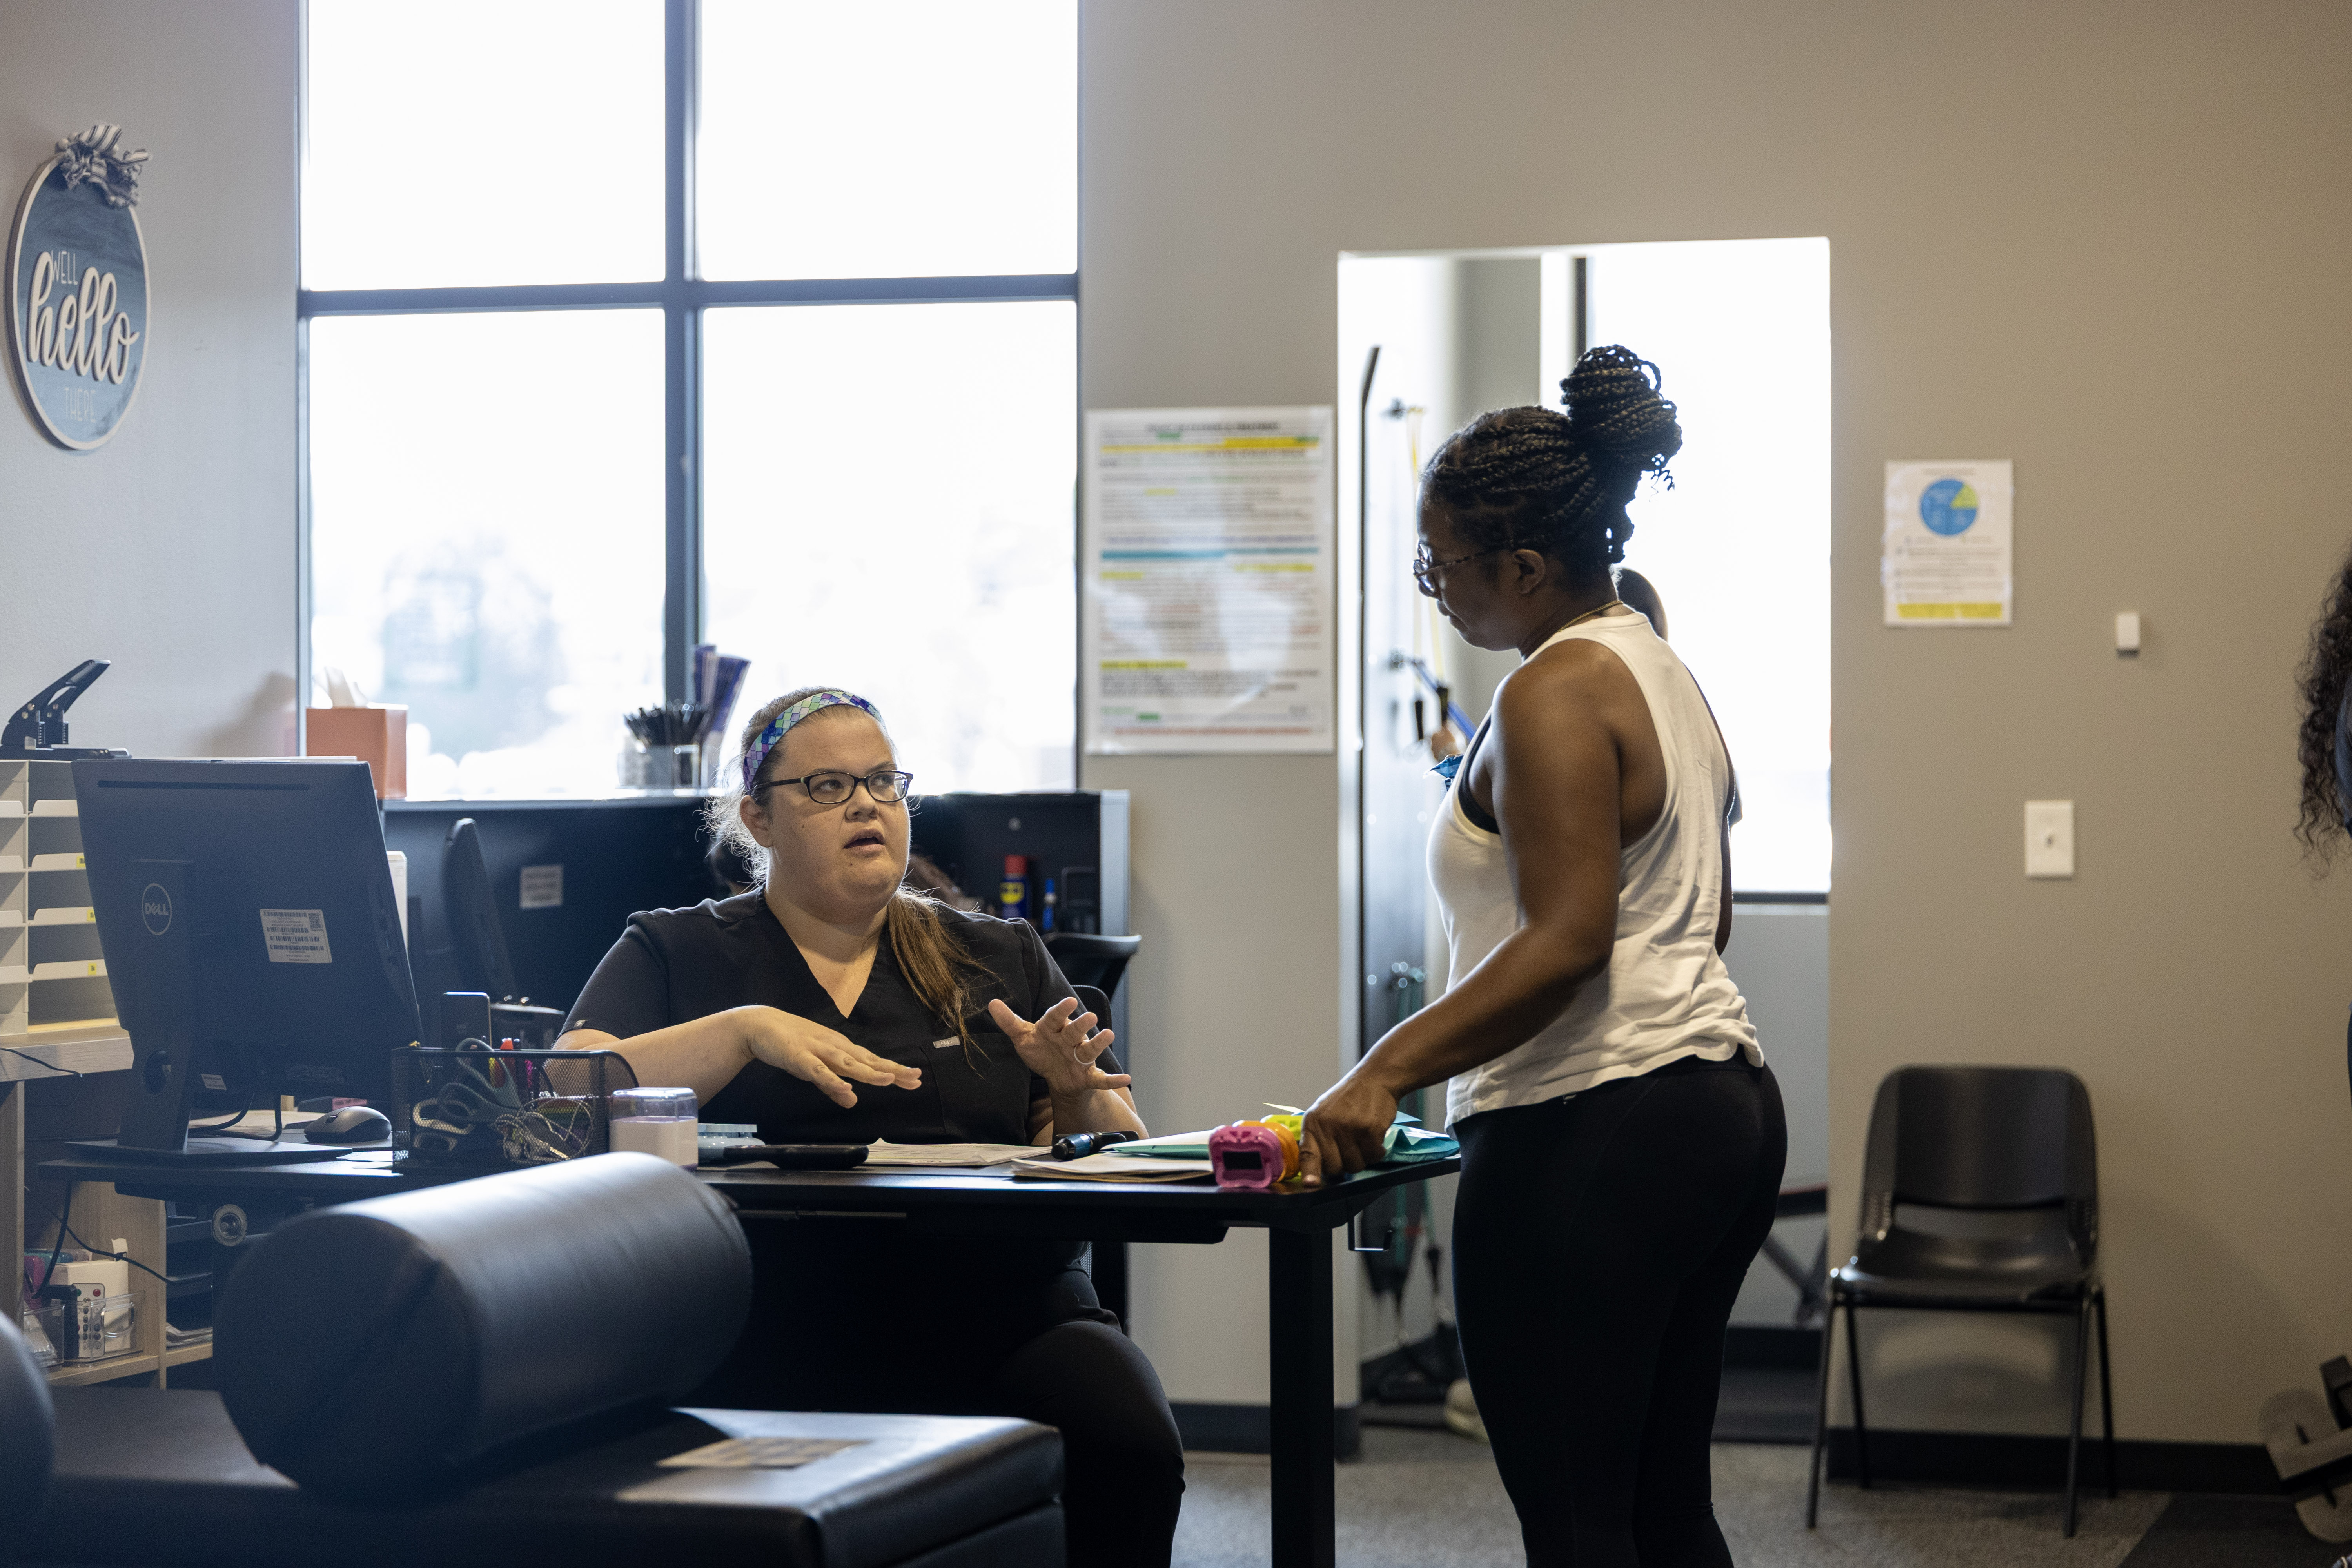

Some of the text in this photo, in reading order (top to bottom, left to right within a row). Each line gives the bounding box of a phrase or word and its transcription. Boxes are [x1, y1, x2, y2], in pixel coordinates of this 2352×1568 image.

[51, 250, 78, 285] WELL
[27, 251, 140, 385] hello
[65, 388, 96, 422] THERE
[145, 903, 169, 915] DELL
